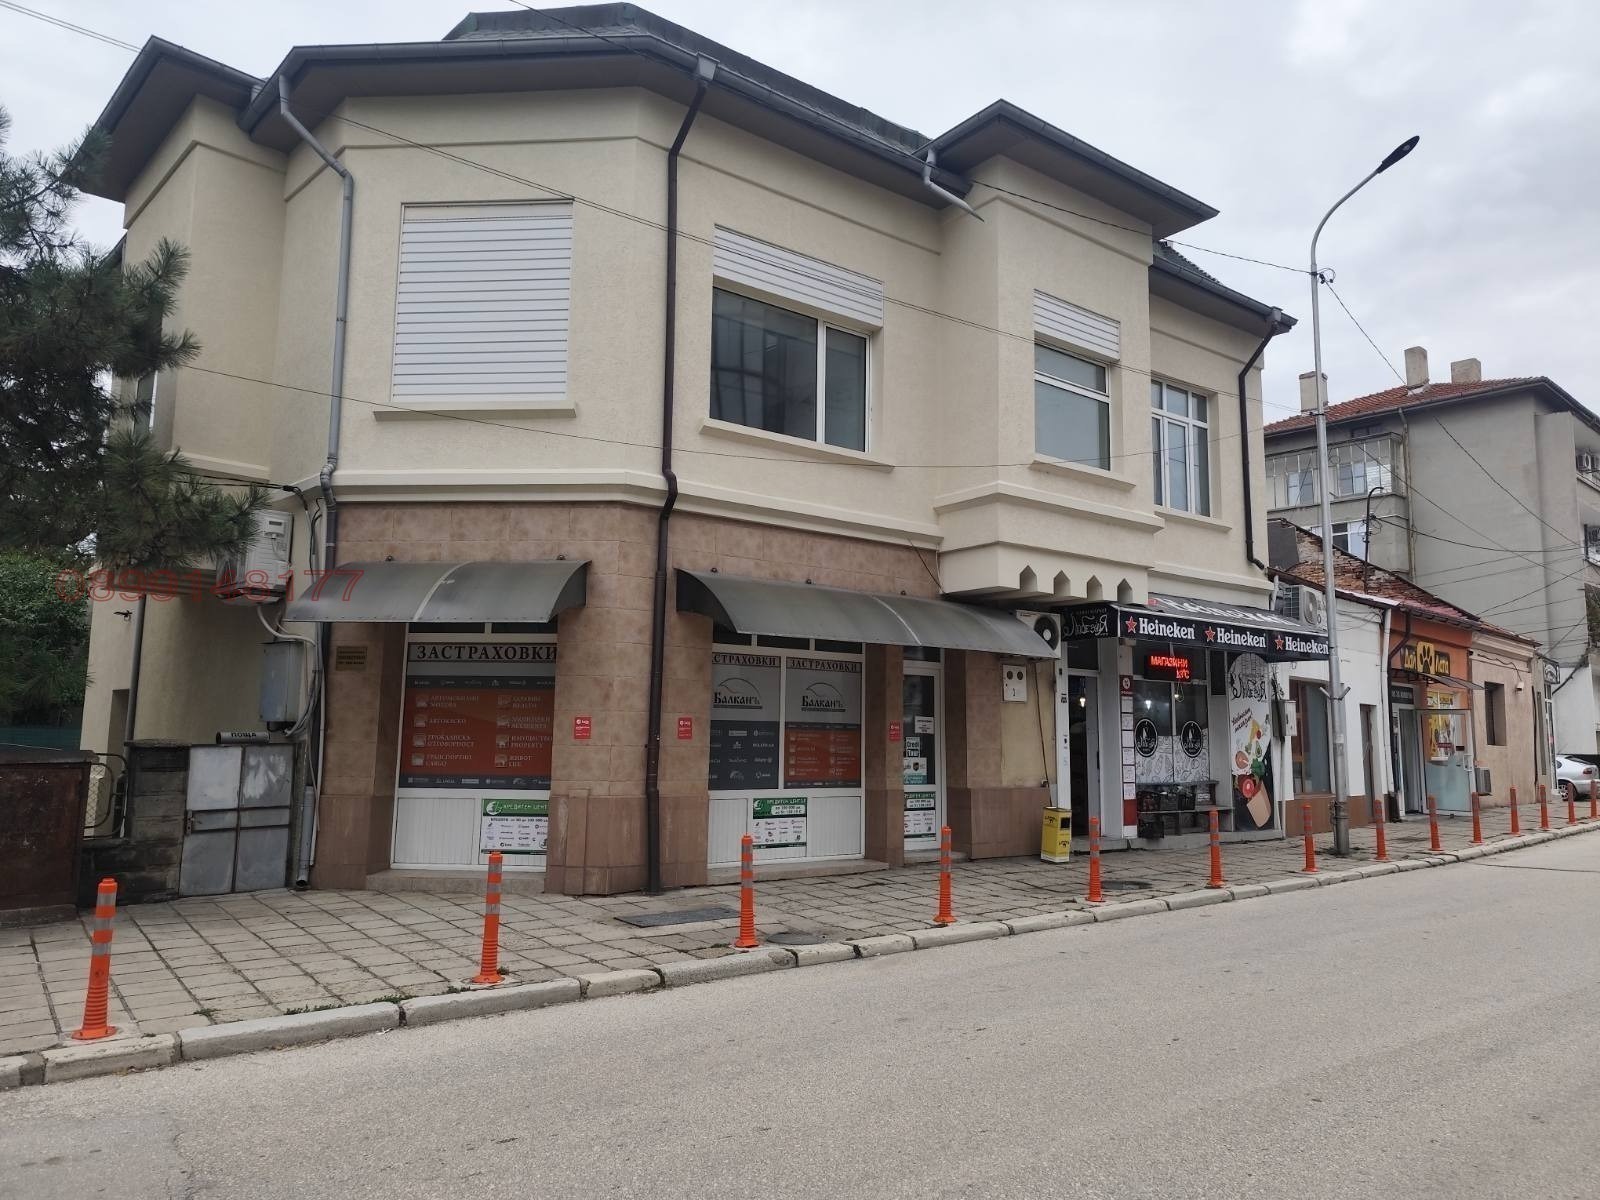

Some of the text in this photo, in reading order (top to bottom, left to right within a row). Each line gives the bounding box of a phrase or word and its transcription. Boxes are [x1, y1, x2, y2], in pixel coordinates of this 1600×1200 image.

[1139, 617, 1328, 655] Heineken Heineken Heineken
[416, 644, 557, 660] ЗАСТРАХОВКИ
[712, 653, 776, 667] СТРАХОВКИ
[791, 660, 857, 673] ЗАСТРАХОВКИ
